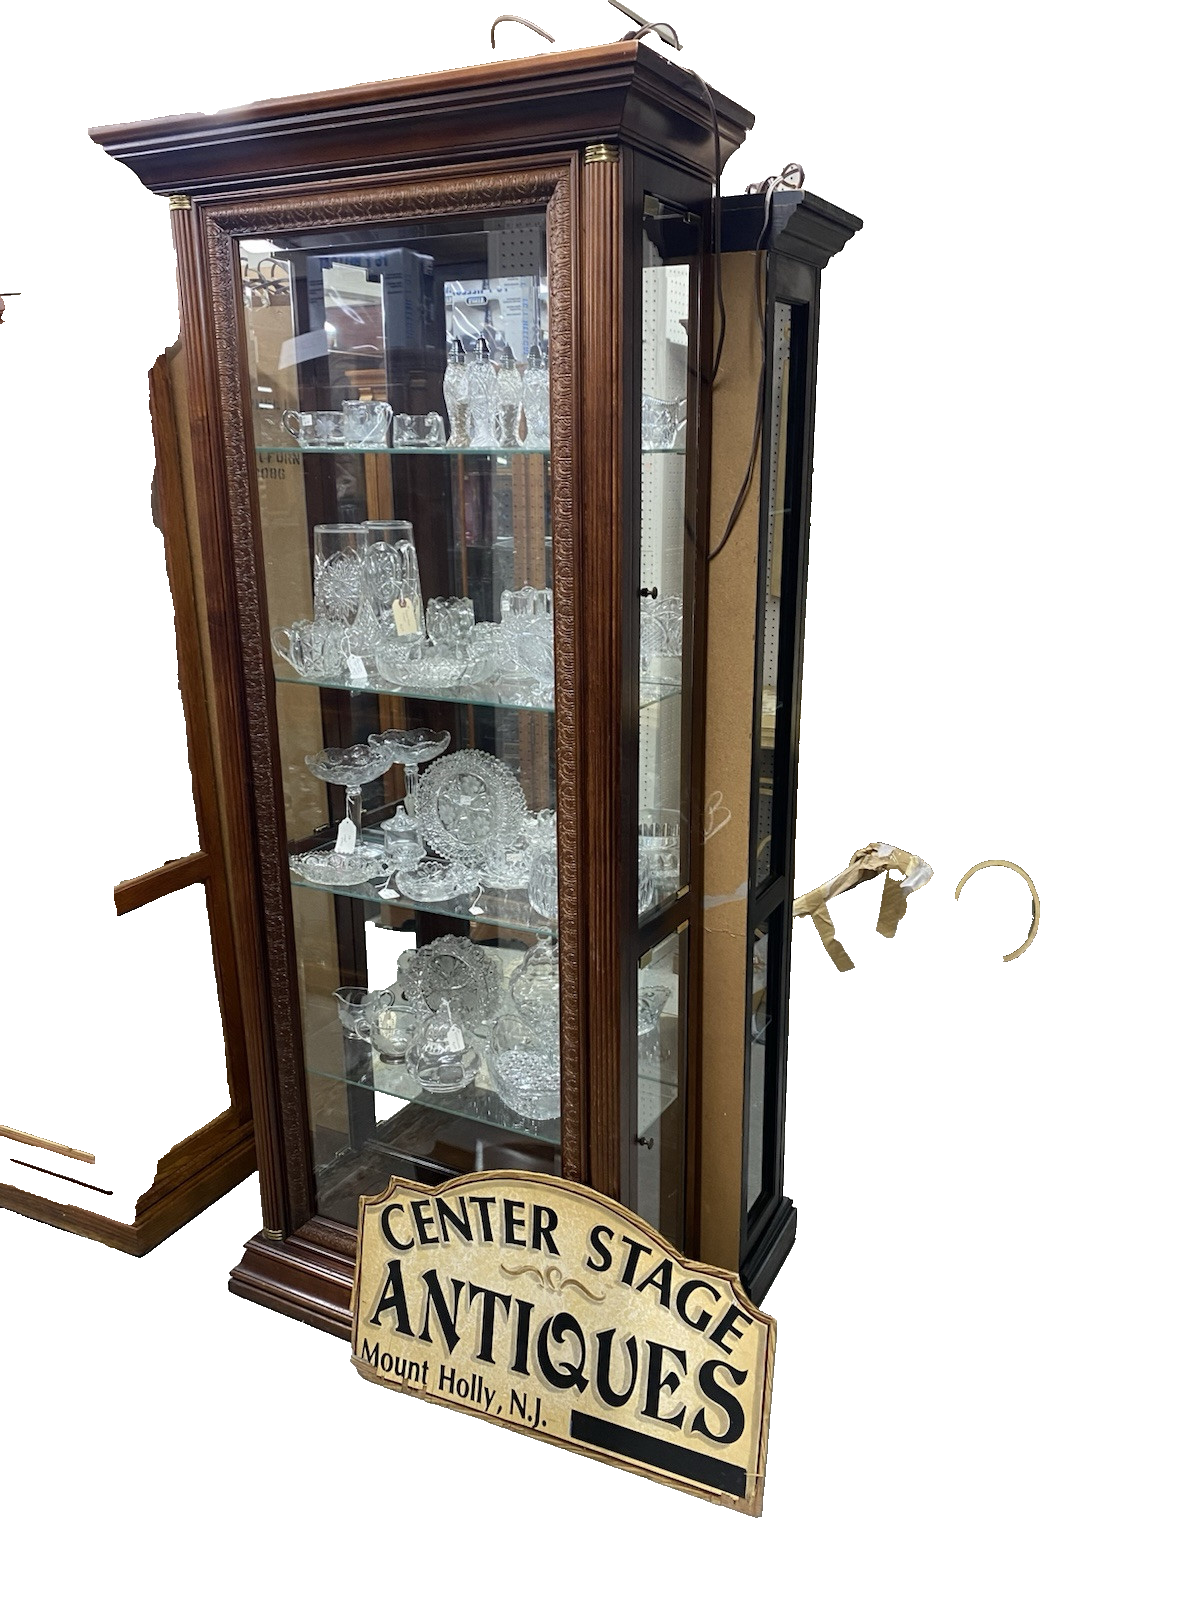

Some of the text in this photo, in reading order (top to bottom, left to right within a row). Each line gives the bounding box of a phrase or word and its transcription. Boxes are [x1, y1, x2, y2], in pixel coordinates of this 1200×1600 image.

[369, 1259, 749, 1445] ANTIQUES
[381, 1196, 753, 1355] CENTER STAGE
[361, 1338, 547, 1428] Mount Holly, N.J.
